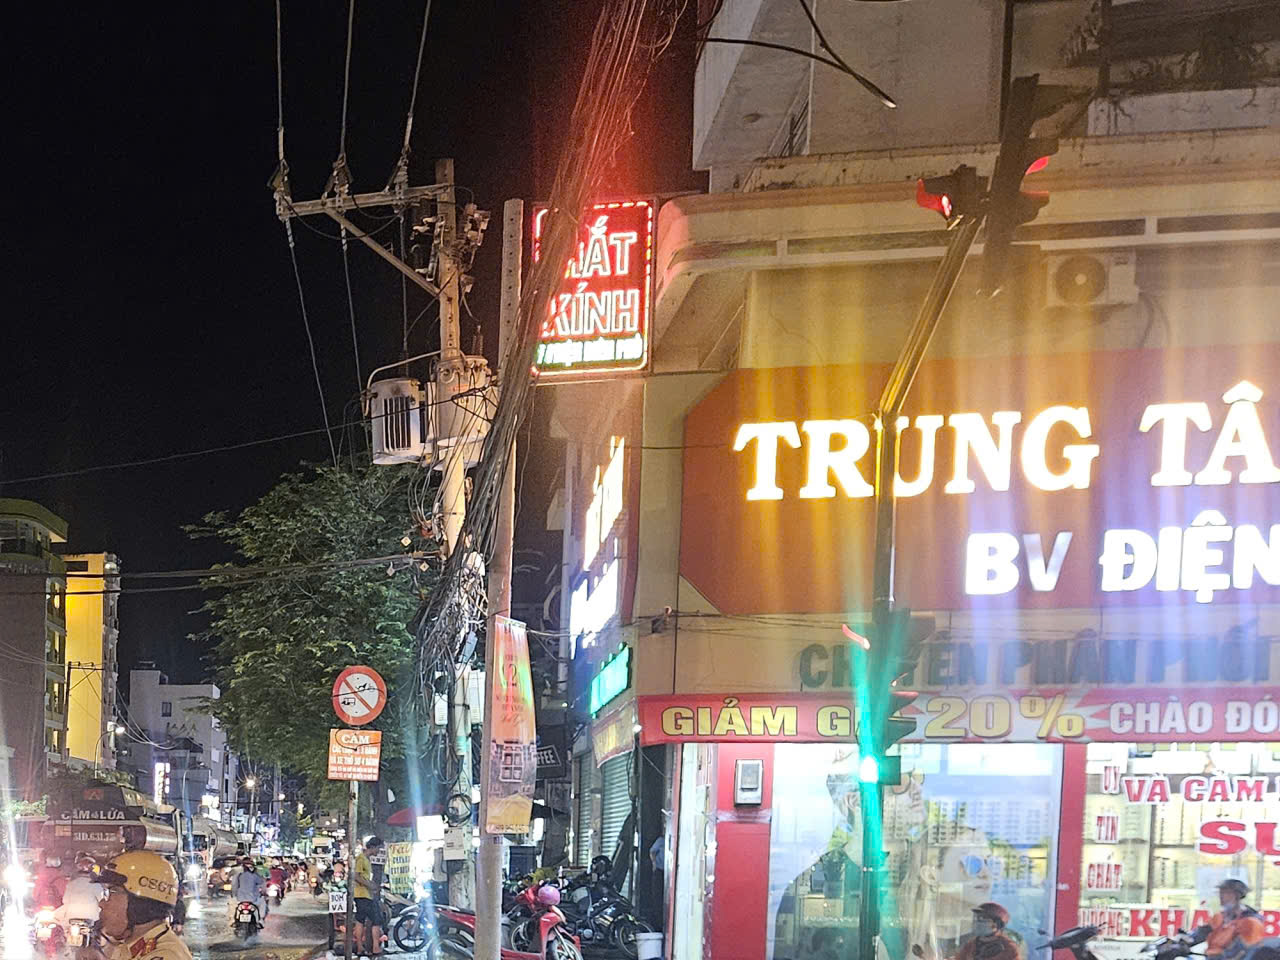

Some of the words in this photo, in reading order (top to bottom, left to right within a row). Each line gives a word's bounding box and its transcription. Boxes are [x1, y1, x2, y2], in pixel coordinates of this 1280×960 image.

[542, 281, 640, 338] KÍNH
[733, 404, 1101, 502] TRUNG
[965, 532, 1073, 595] BV
[1099, 509, 1280, 604] ĐIỆN
[662, 697, 797, 738] GIẢM
[924, 695, 1086, 739] 20%
[1109, 695, 1213, 734] CHÀO
[1224, 694, 1280, 734] ĐÓ
[1124, 771, 1169, 803] VÀ
[138, 875, 174, 896] CSGT
[1129, 900, 1220, 937] KHÁ
